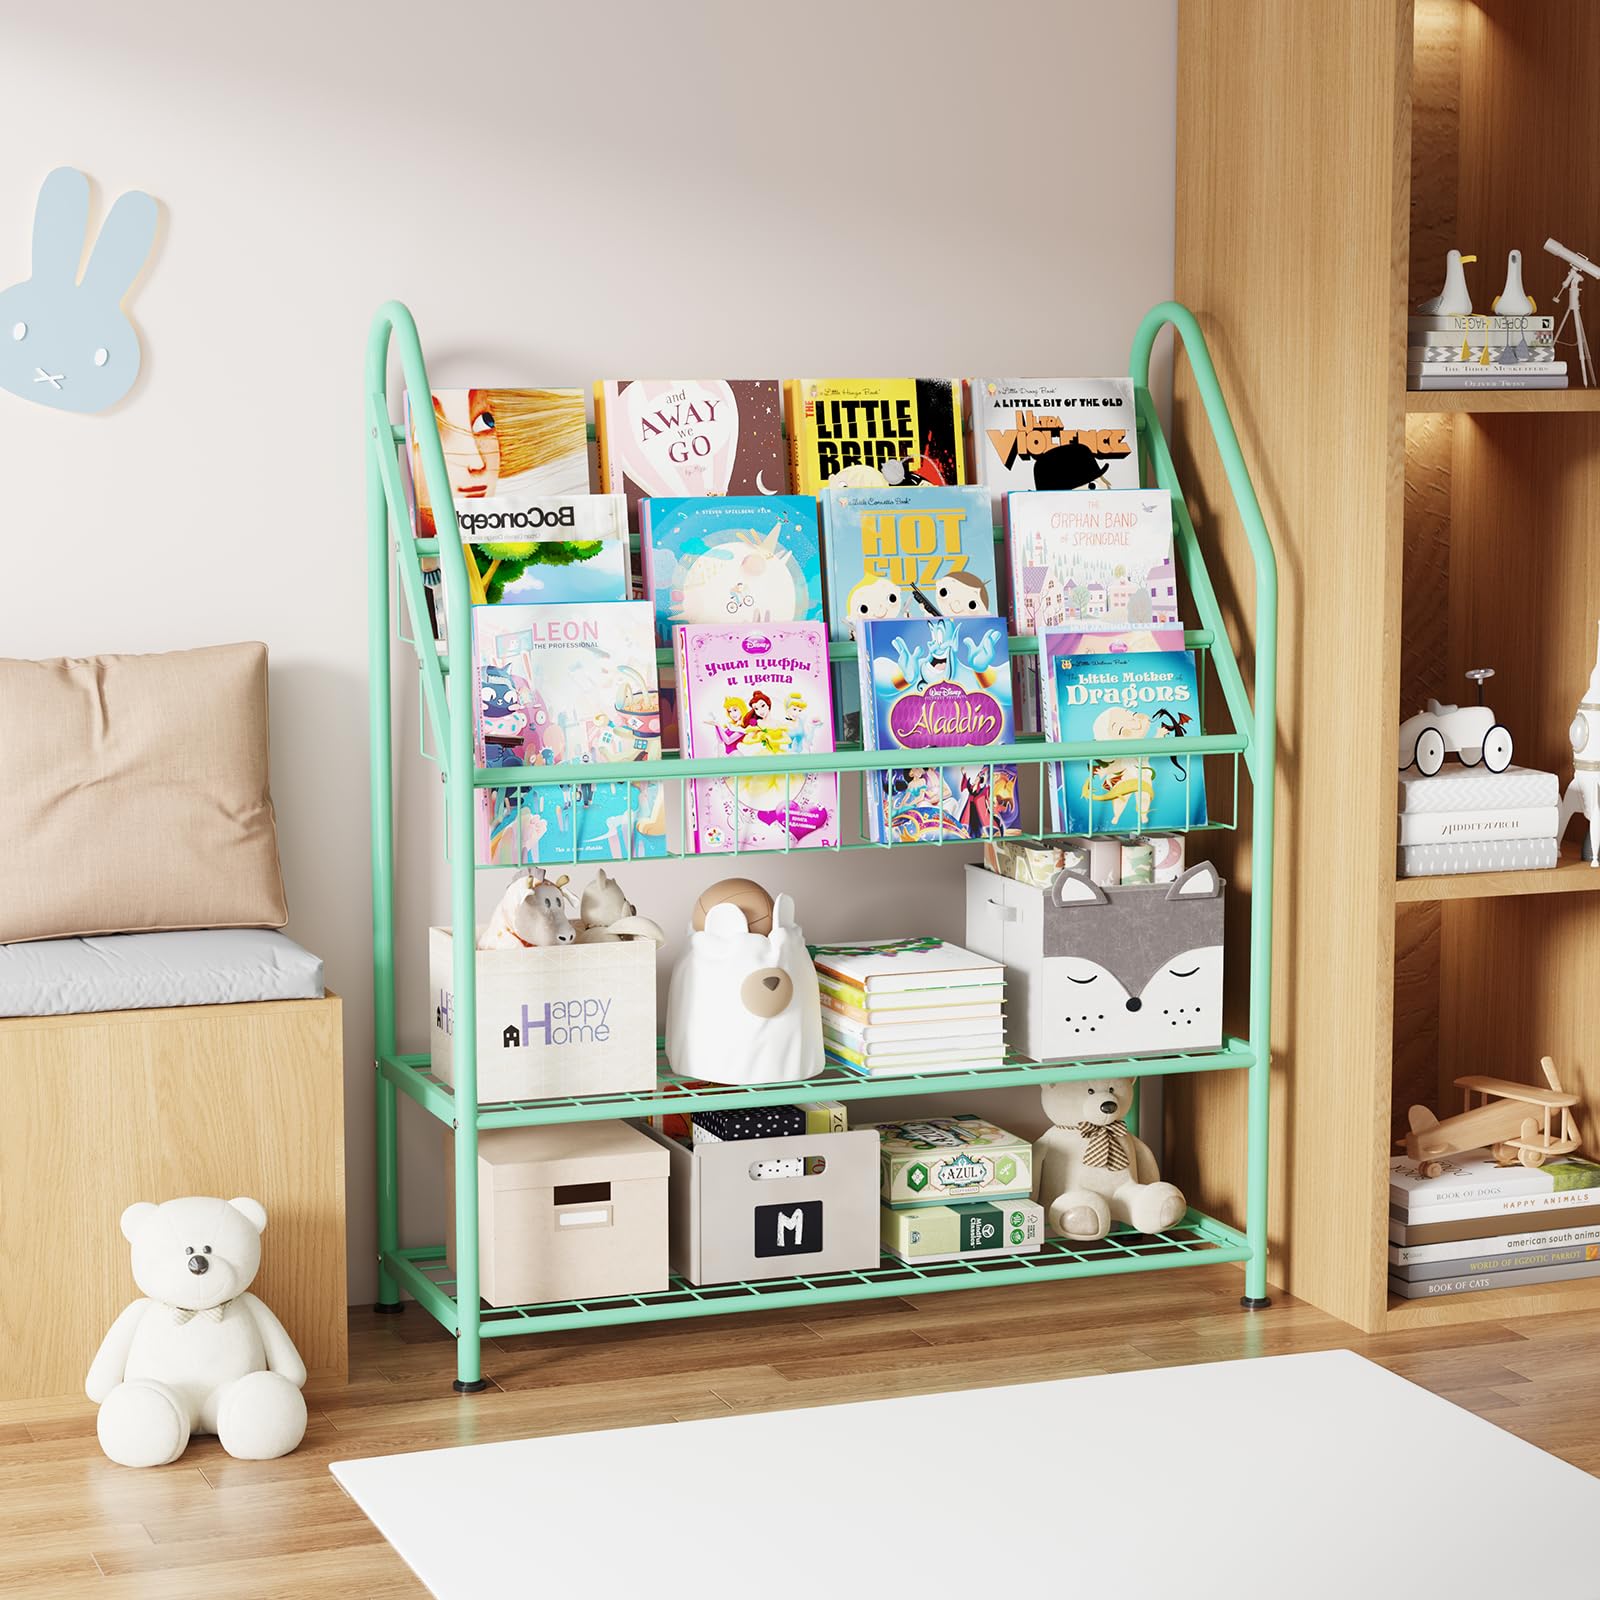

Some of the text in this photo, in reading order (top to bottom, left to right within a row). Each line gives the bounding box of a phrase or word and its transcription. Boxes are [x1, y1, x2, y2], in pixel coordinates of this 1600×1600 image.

[666, 389, 686, 404] and
[994, 398, 1123, 408] A LITTLE BIT OF THE OLD
[805, 400, 814, 418] THE
[641, 400, 720, 441] AWAY
[815, 400, 914, 438] LITTLE
[677, 428, 694, 438] we
[668, 436, 711, 463] GO
[986, 429, 1132, 468] VIOLENCE
[1050, 512, 1137, 528] ORPHAN BAND
[860, 514, 967, 556] HOT
[1072, 532, 1129, 546] SPRINGDALE
[532, 620, 598, 641] LEON
[756, 657, 811, 671] цифры
[727, 674, 793, 686] и цвета
[1078, 672, 1119, 684] Little
[1122, 672, 1174, 682] Mother
[1066, 684, 1190, 708] Dragons
[898, 700, 996, 738] Aladdin
[521, 998, 611, 1046] Happy
[946, 1166, 978, 1180] AZUL
[1436, 1188, 1502, 1200] BOOK OF DOGS
[1503, 1194, 1590, 1209] HAPPY ANIMALS
[776, 1208, 804, 1247] M
[1507, 1237, 1547, 1248] american
[1549, 1232, 1572, 1242] south
[1470, 1250, 1582, 1271] WORLD OF EGZOTIC PARROT
[1428, 1278, 1490, 1294] BOOK OF CATS
